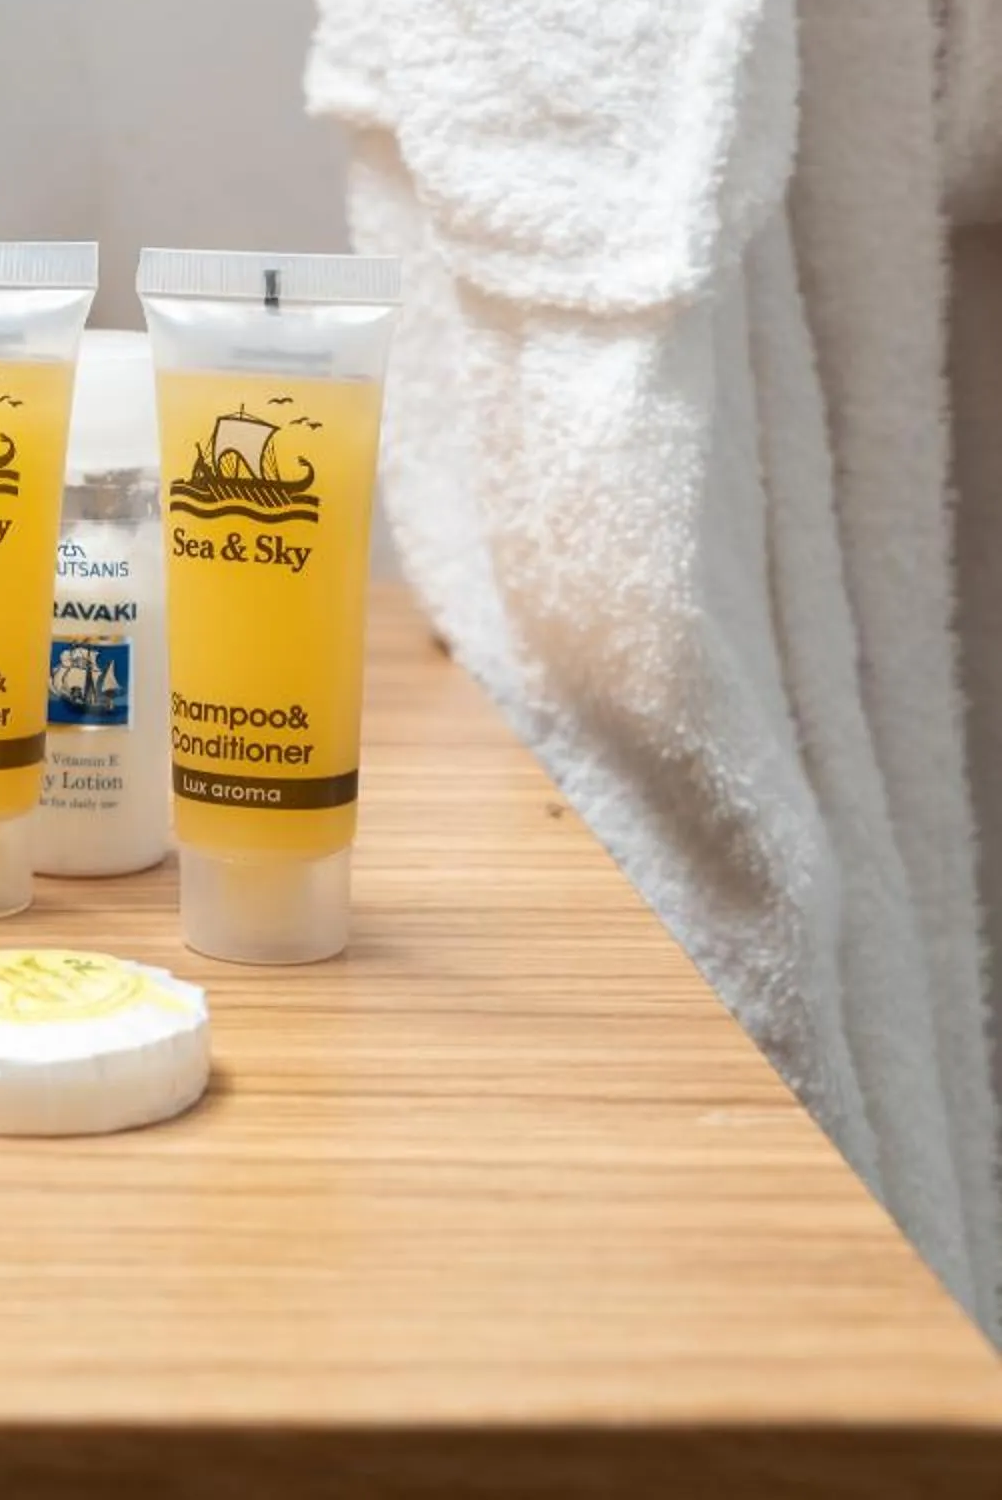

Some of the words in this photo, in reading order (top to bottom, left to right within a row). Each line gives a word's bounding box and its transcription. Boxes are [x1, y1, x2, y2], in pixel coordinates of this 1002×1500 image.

[173, 527, 215, 560] Sea
[220, 532, 249, 562] &
[254, 534, 313, 573] Sky
[171, 691, 309, 730] Shampoo&
[171, 726, 314, 764] Conditioner
[62, 771, 124, 790] Lotion
[183, 774, 207, 795] Lux
[211, 779, 281, 802] aroma
